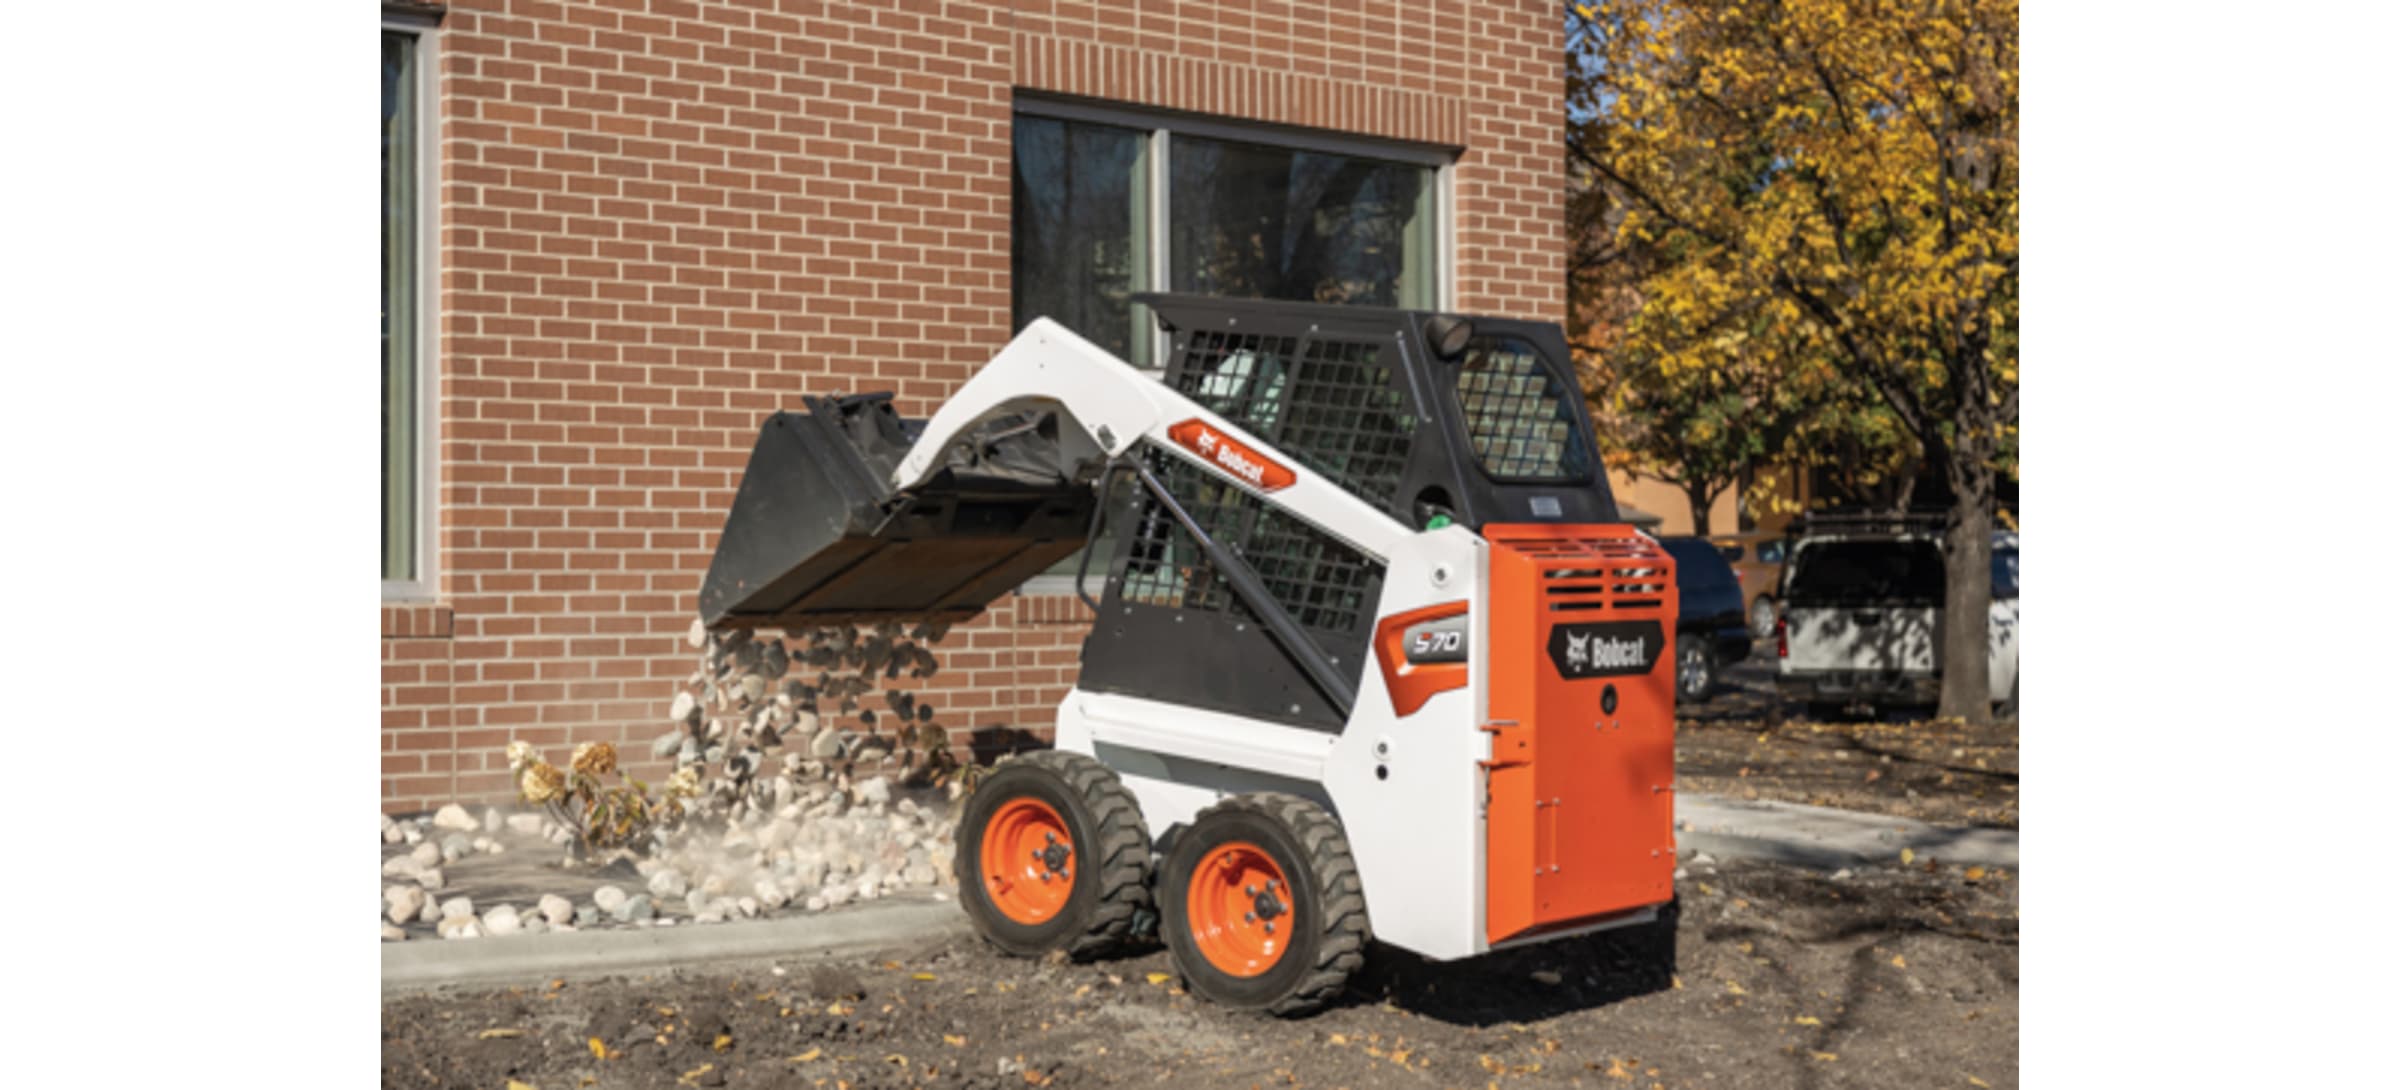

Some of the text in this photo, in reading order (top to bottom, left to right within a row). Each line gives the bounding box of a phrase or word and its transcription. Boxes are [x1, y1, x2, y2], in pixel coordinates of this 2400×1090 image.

[1216, 443, 1264, 483] Bobcat
[1413, 631, 1461, 654] S70
[1592, 635, 1645, 668] Bobcat
